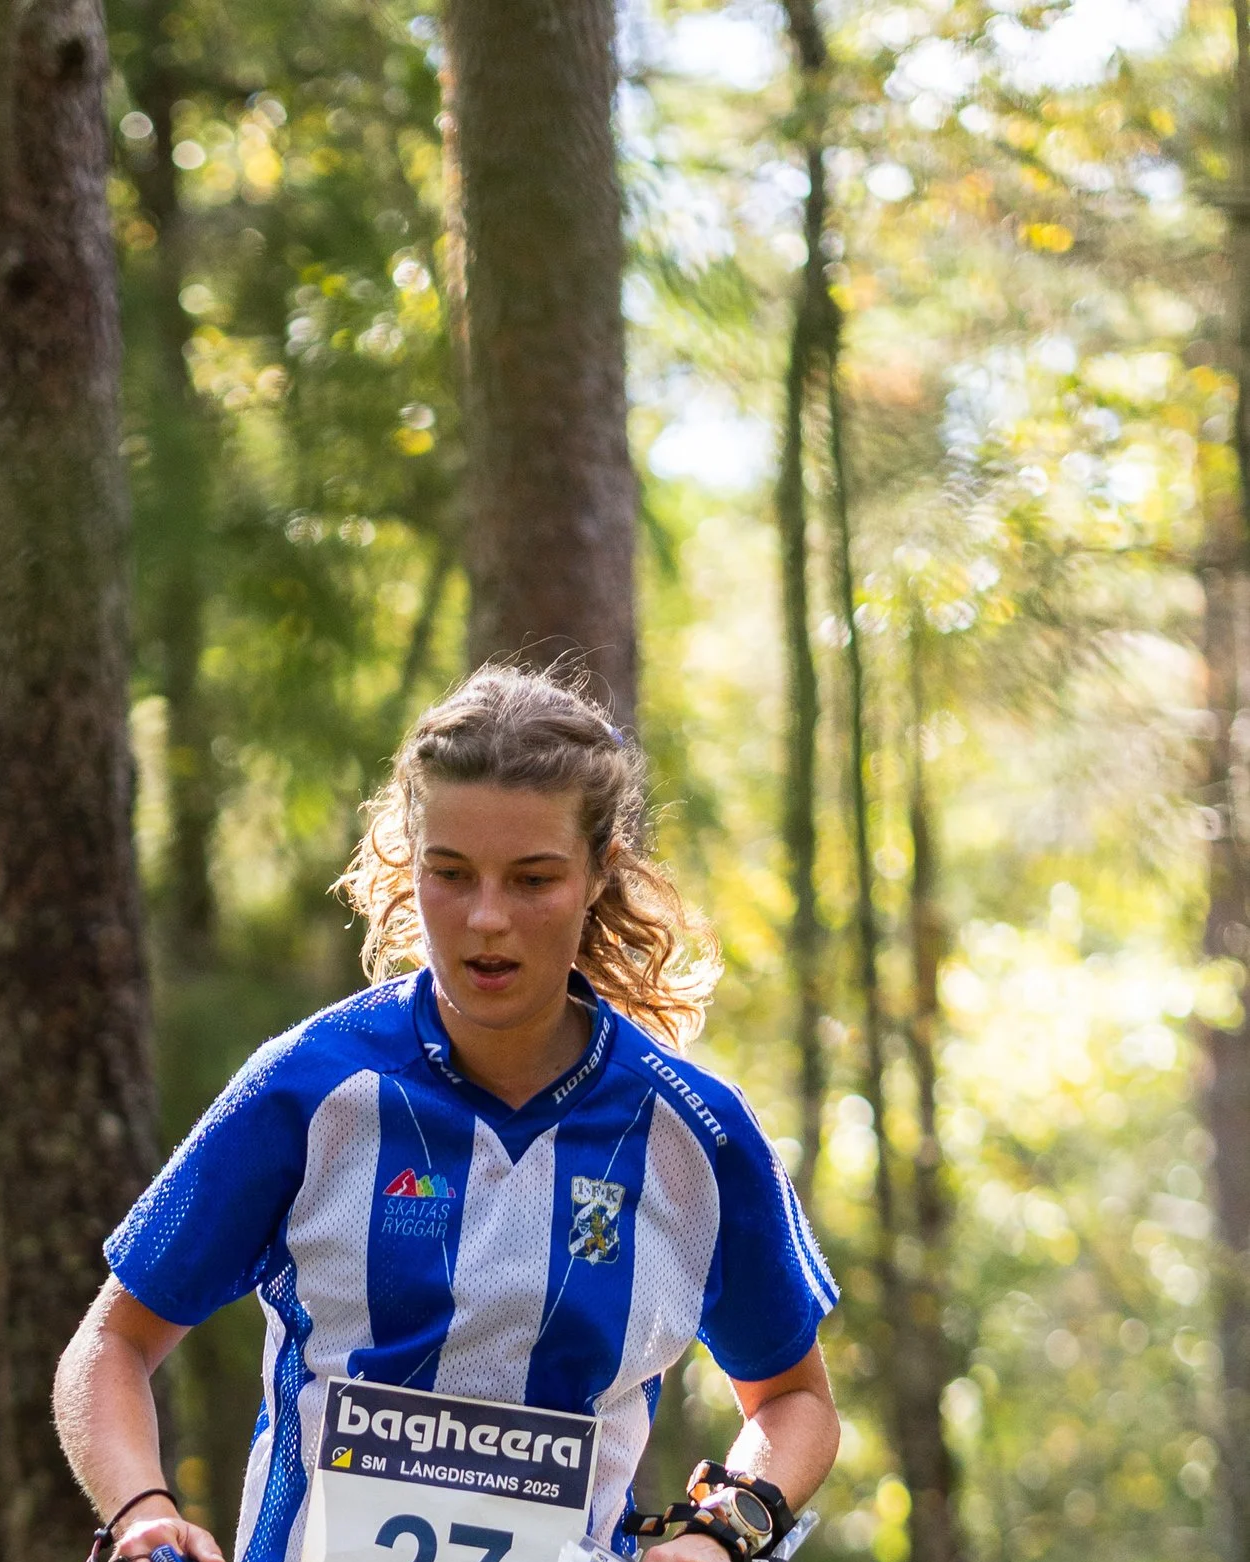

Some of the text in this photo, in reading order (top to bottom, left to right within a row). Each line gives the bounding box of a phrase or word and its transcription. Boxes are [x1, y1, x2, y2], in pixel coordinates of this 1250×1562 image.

[553, 1016, 611, 1105] noname
[641, 1052, 727, 1147] noname
[381, 1216, 448, 1239] RYGGAR
[336, 1395, 582, 1469] bagheera
[361, 1454, 560, 1498] SM LÅNGDISTANS 2025
